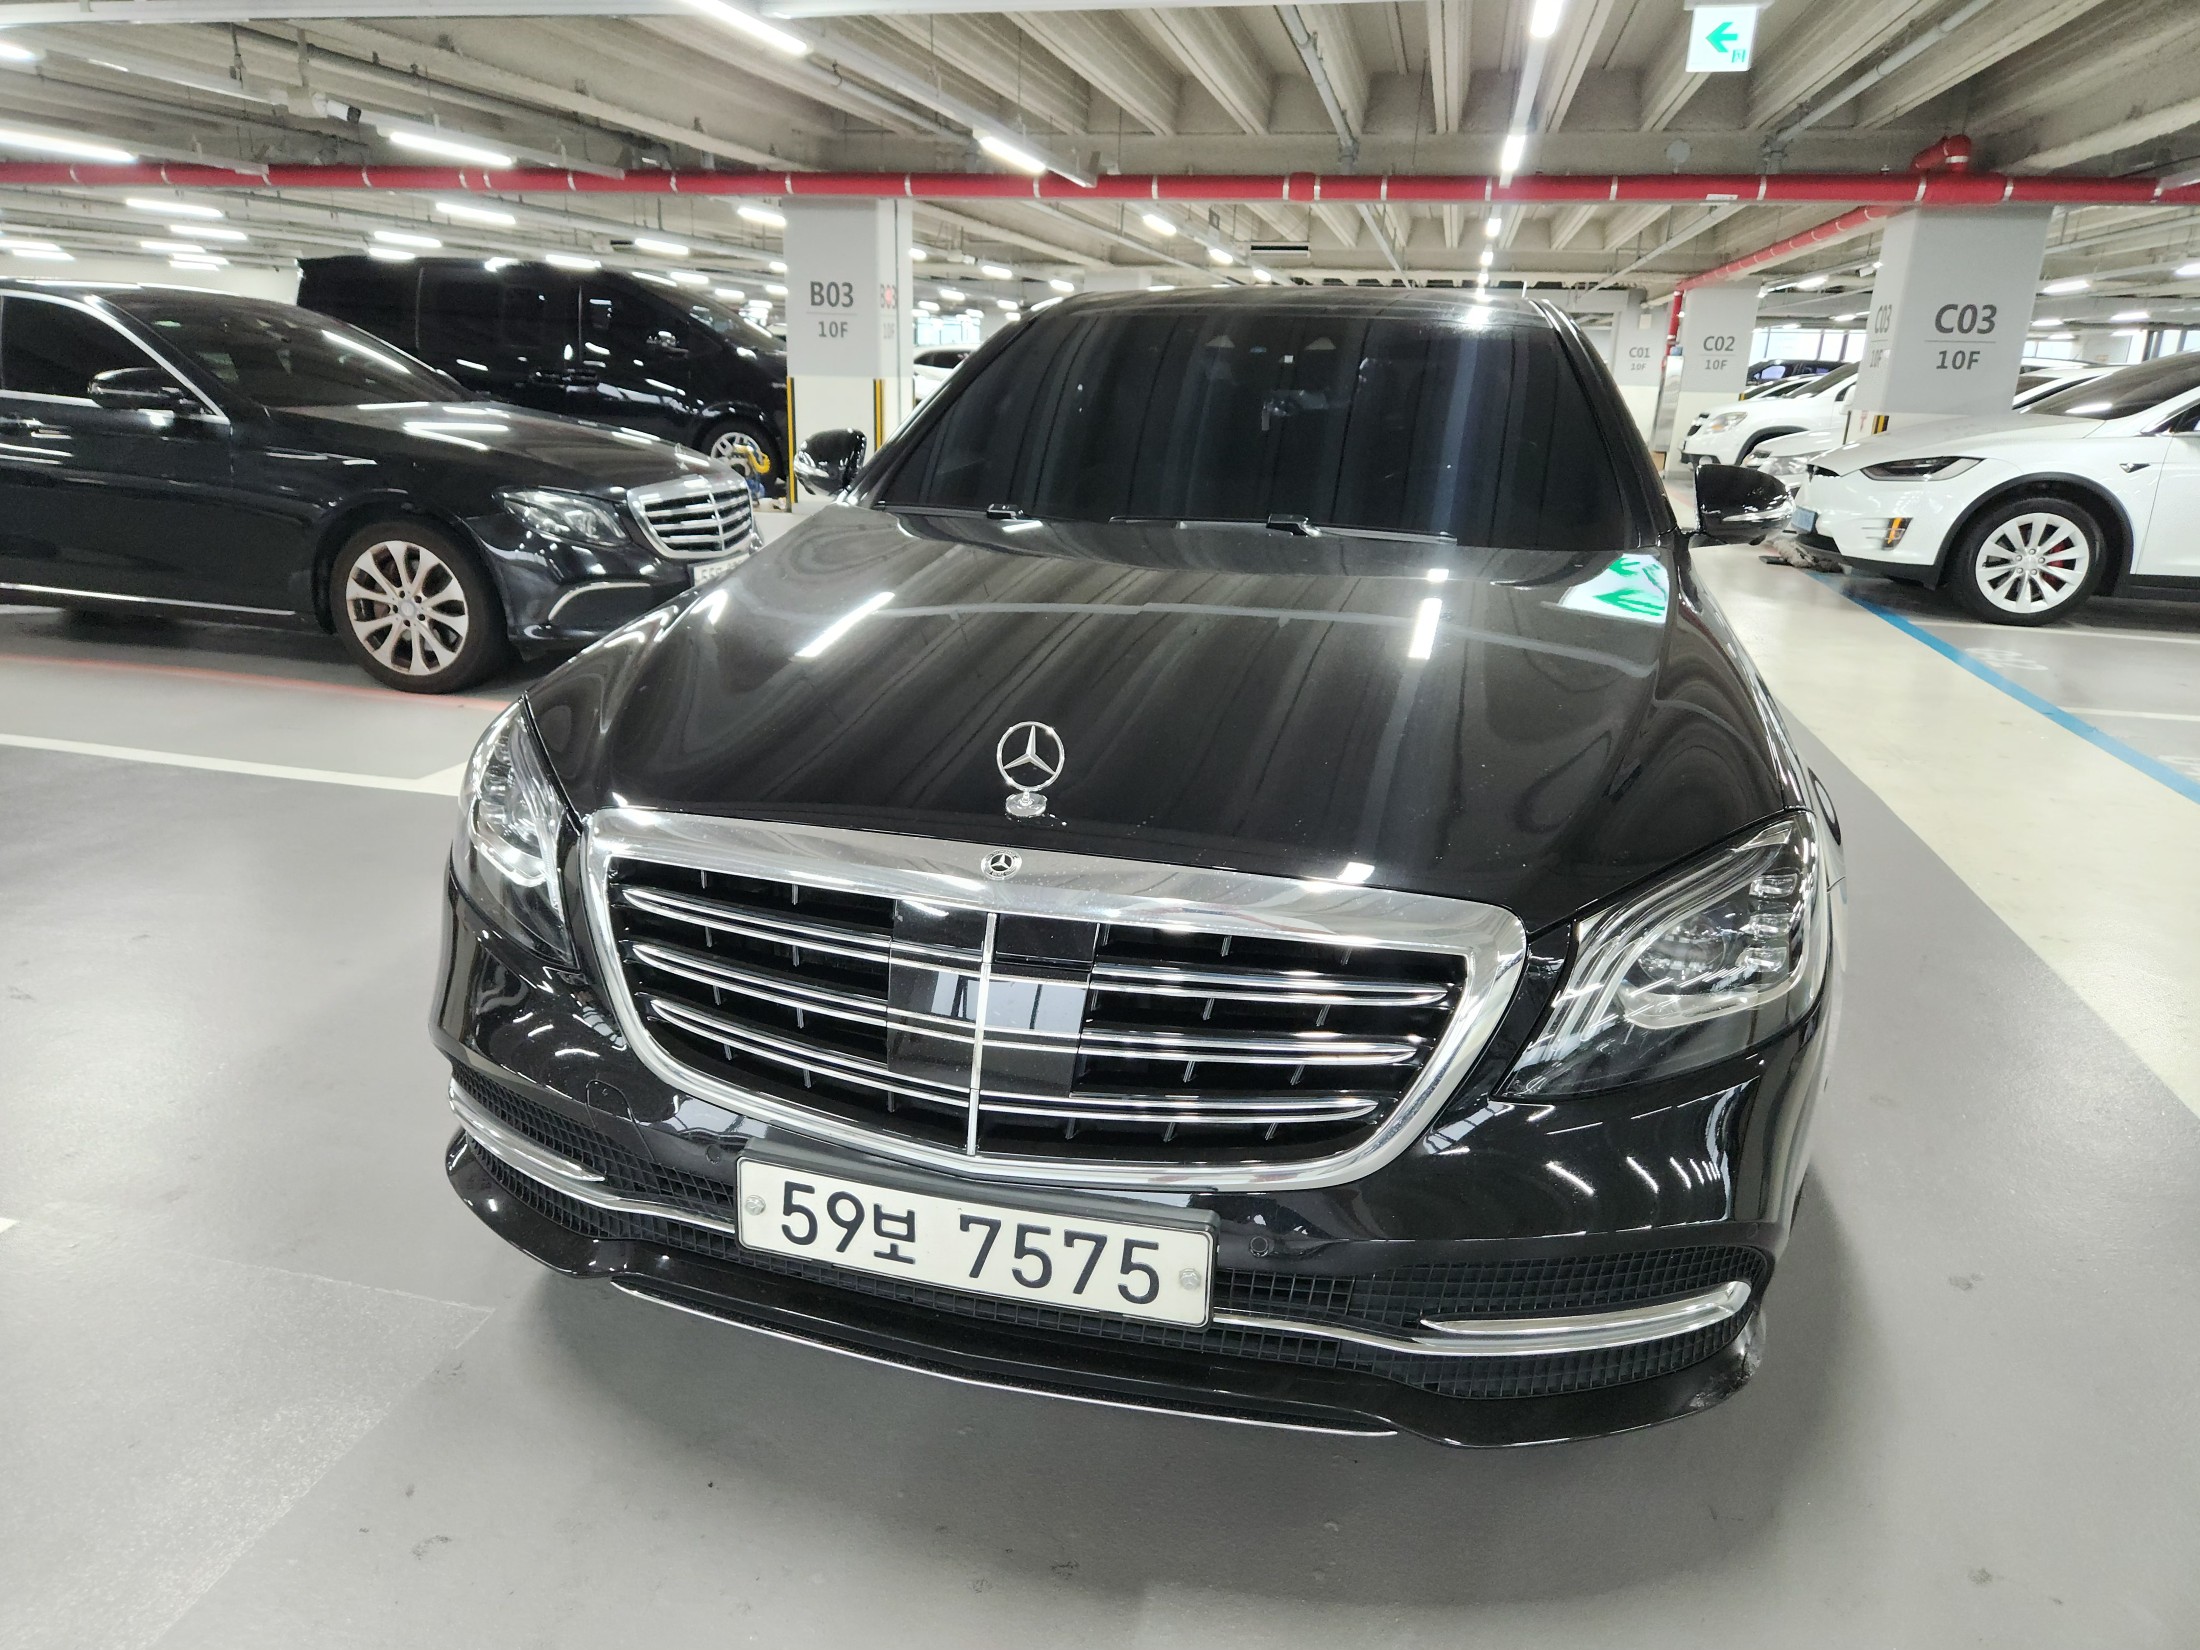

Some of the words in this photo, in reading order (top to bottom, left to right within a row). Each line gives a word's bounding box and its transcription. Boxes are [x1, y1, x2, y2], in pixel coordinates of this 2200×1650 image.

[810, 281, 854, 307] B03
[1934, 303, 1998, 335] C03
[818, 321, 849, 338] 10F
[1629, 347, 1651, 358] C01
[1703, 336, 1736, 351] C02
[1704, 359, 1728, 370] 10F
[1936, 350, 1981, 370] 10F
[781, 1180, 917, 1265] 59보
[959, 1213, 1162, 1305] 7575
